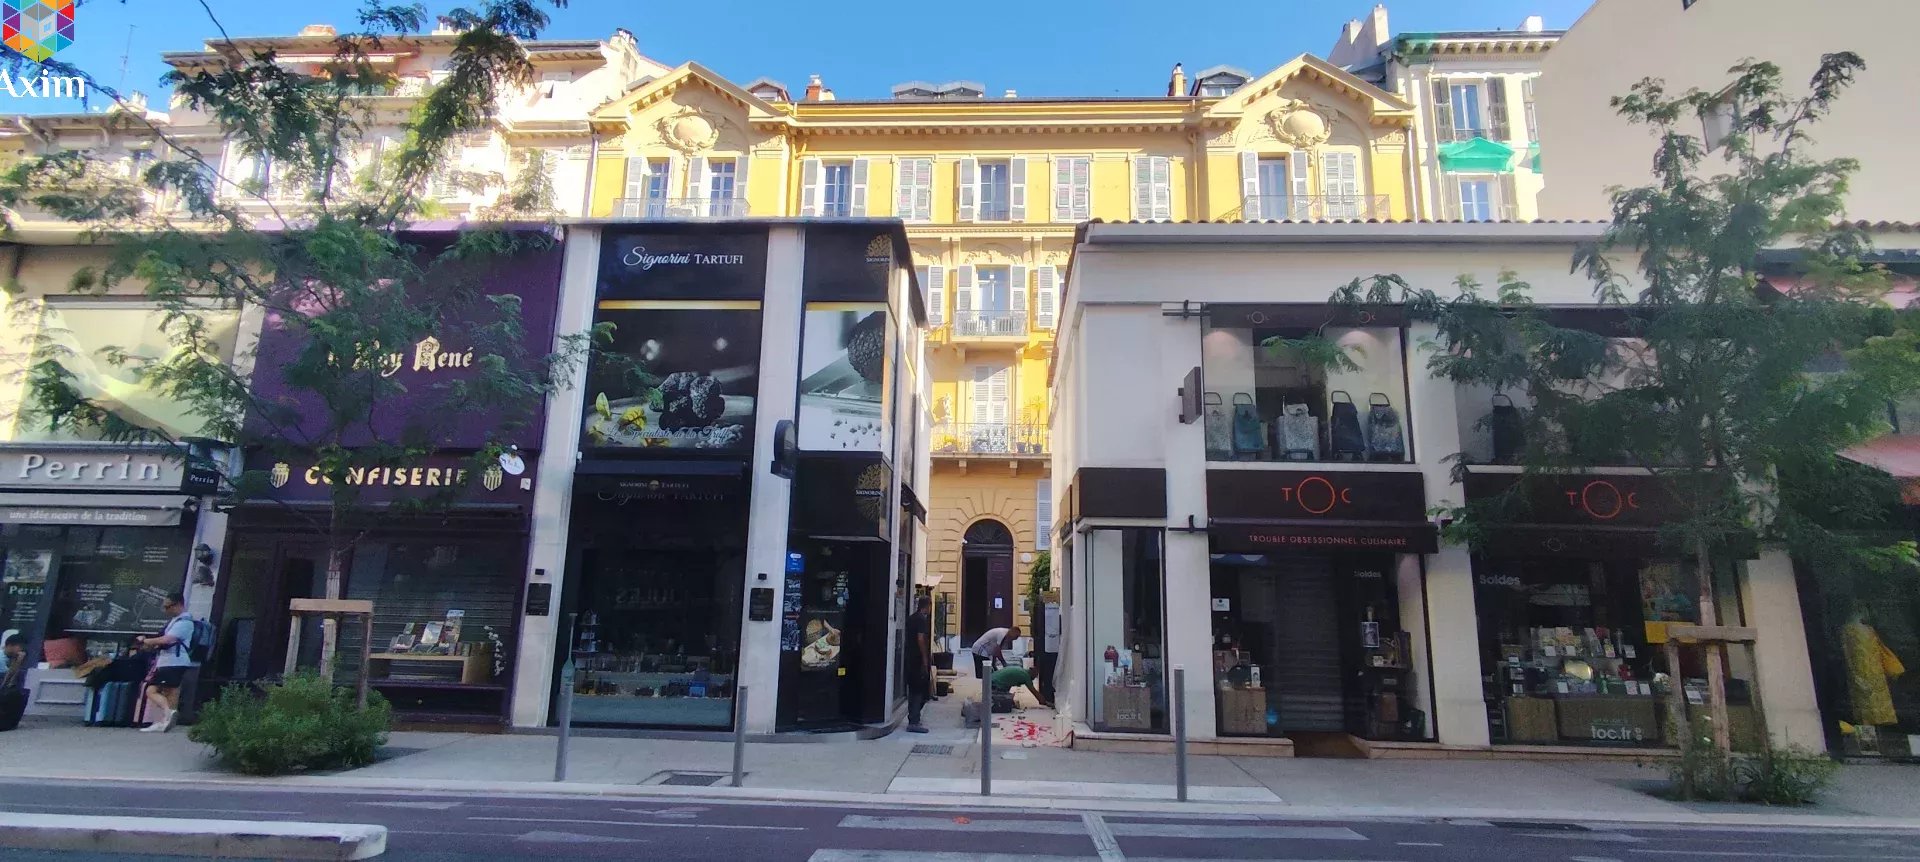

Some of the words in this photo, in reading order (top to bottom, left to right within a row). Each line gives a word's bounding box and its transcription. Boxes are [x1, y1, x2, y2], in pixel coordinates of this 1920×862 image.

[623, 246, 691, 271] Signorini
[694, 253, 744, 265] TARTUFI
[412, 335, 474, 373] René
[18, 453, 161, 481] Perrin
[190, 474, 215, 484] Perrin
[1281, 476, 1352, 514] TOC
[1566, 480, 1640, 519] TOC
[9, 511, 26, 520] une
[51, 512, 79, 521] neuve
[81, 511, 92, 521] de
[94, 511, 104, 521] la
[105, 511, 147, 522] tradition
[1249, 535, 1287, 543] TROUBLE
[1289, 536, 1357, 545] OBSESSIONNEL
[1360, 538, 1407, 546] CULINAIRE
[1479, 575, 1521, 586] Soldes
[1590, 725, 1633, 740] toc.fr
